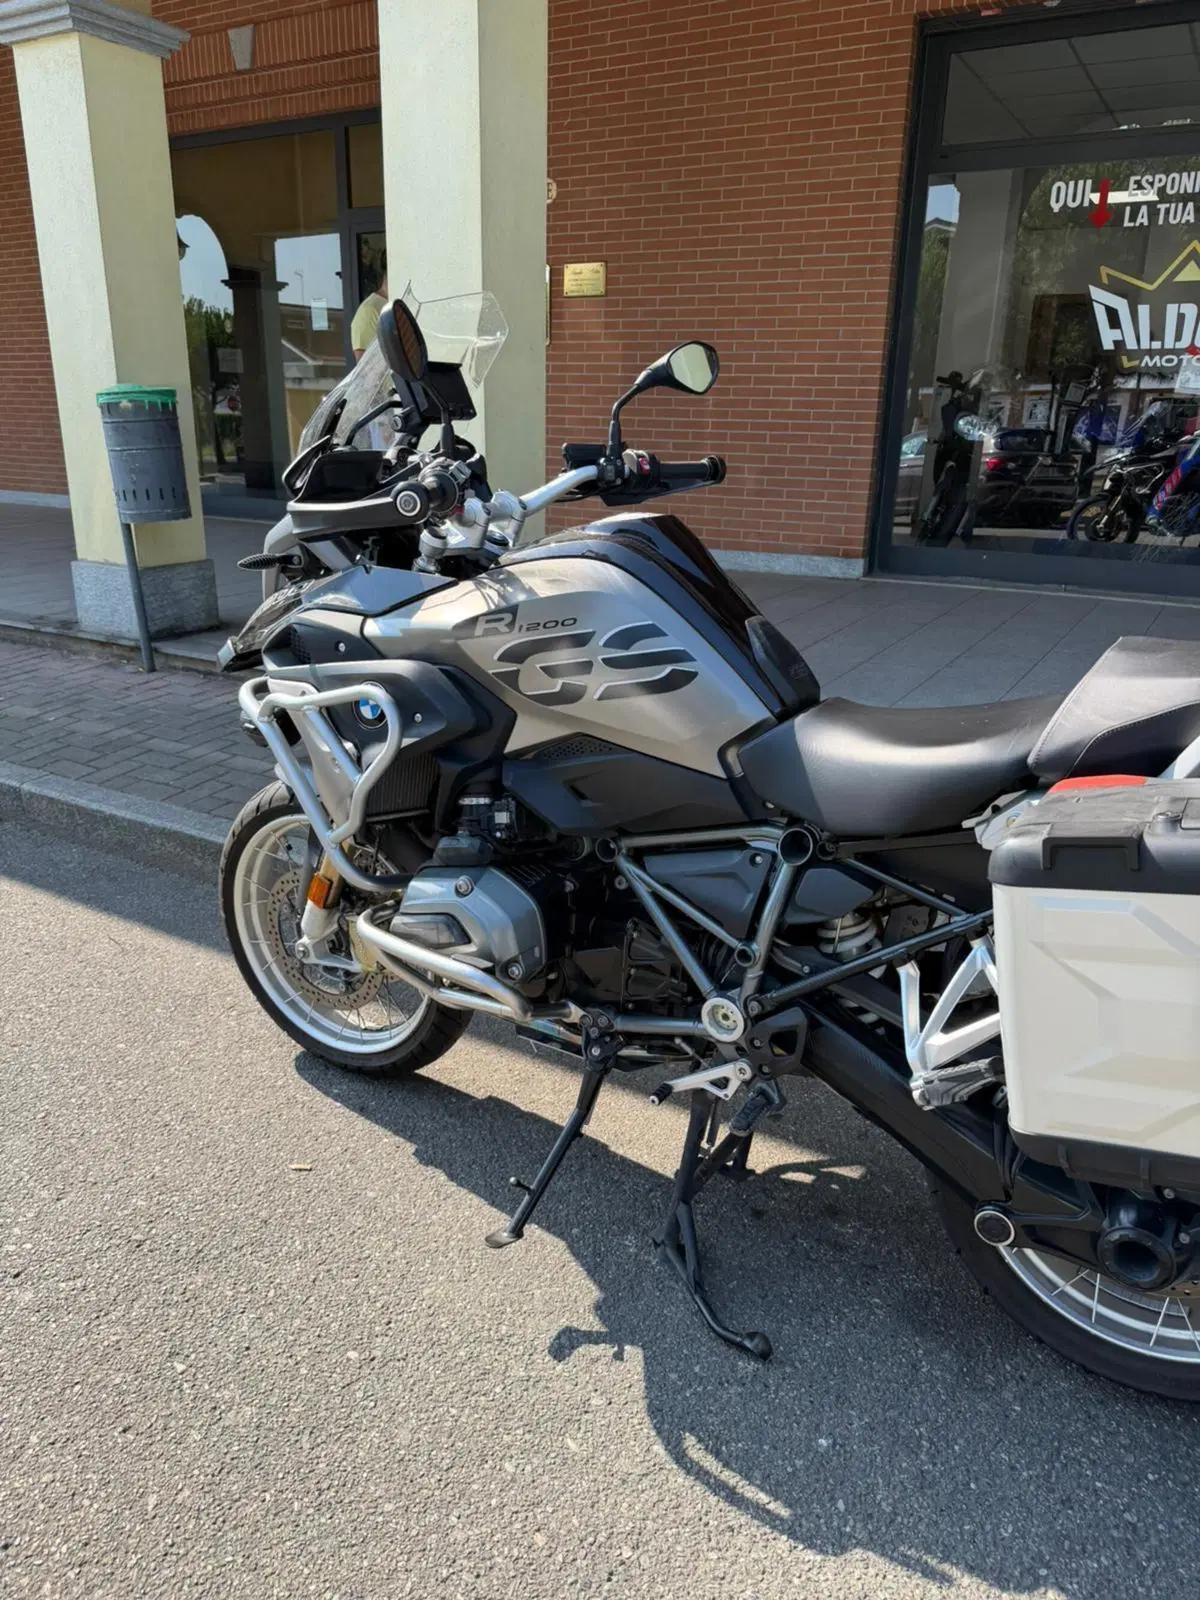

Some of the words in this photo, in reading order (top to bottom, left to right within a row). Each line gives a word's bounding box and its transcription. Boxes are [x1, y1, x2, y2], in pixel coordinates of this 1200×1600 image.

[1050, 179, 1093, 213] QUI
[1123, 204, 1149, 227] LA
[1157, 201, 1195, 226] TUA
[1088, 284, 1200, 350] ALD
[474, 612, 513, 637] R
[518, 617, 578, 633] 1200
[487, 621, 699, 707] GS
